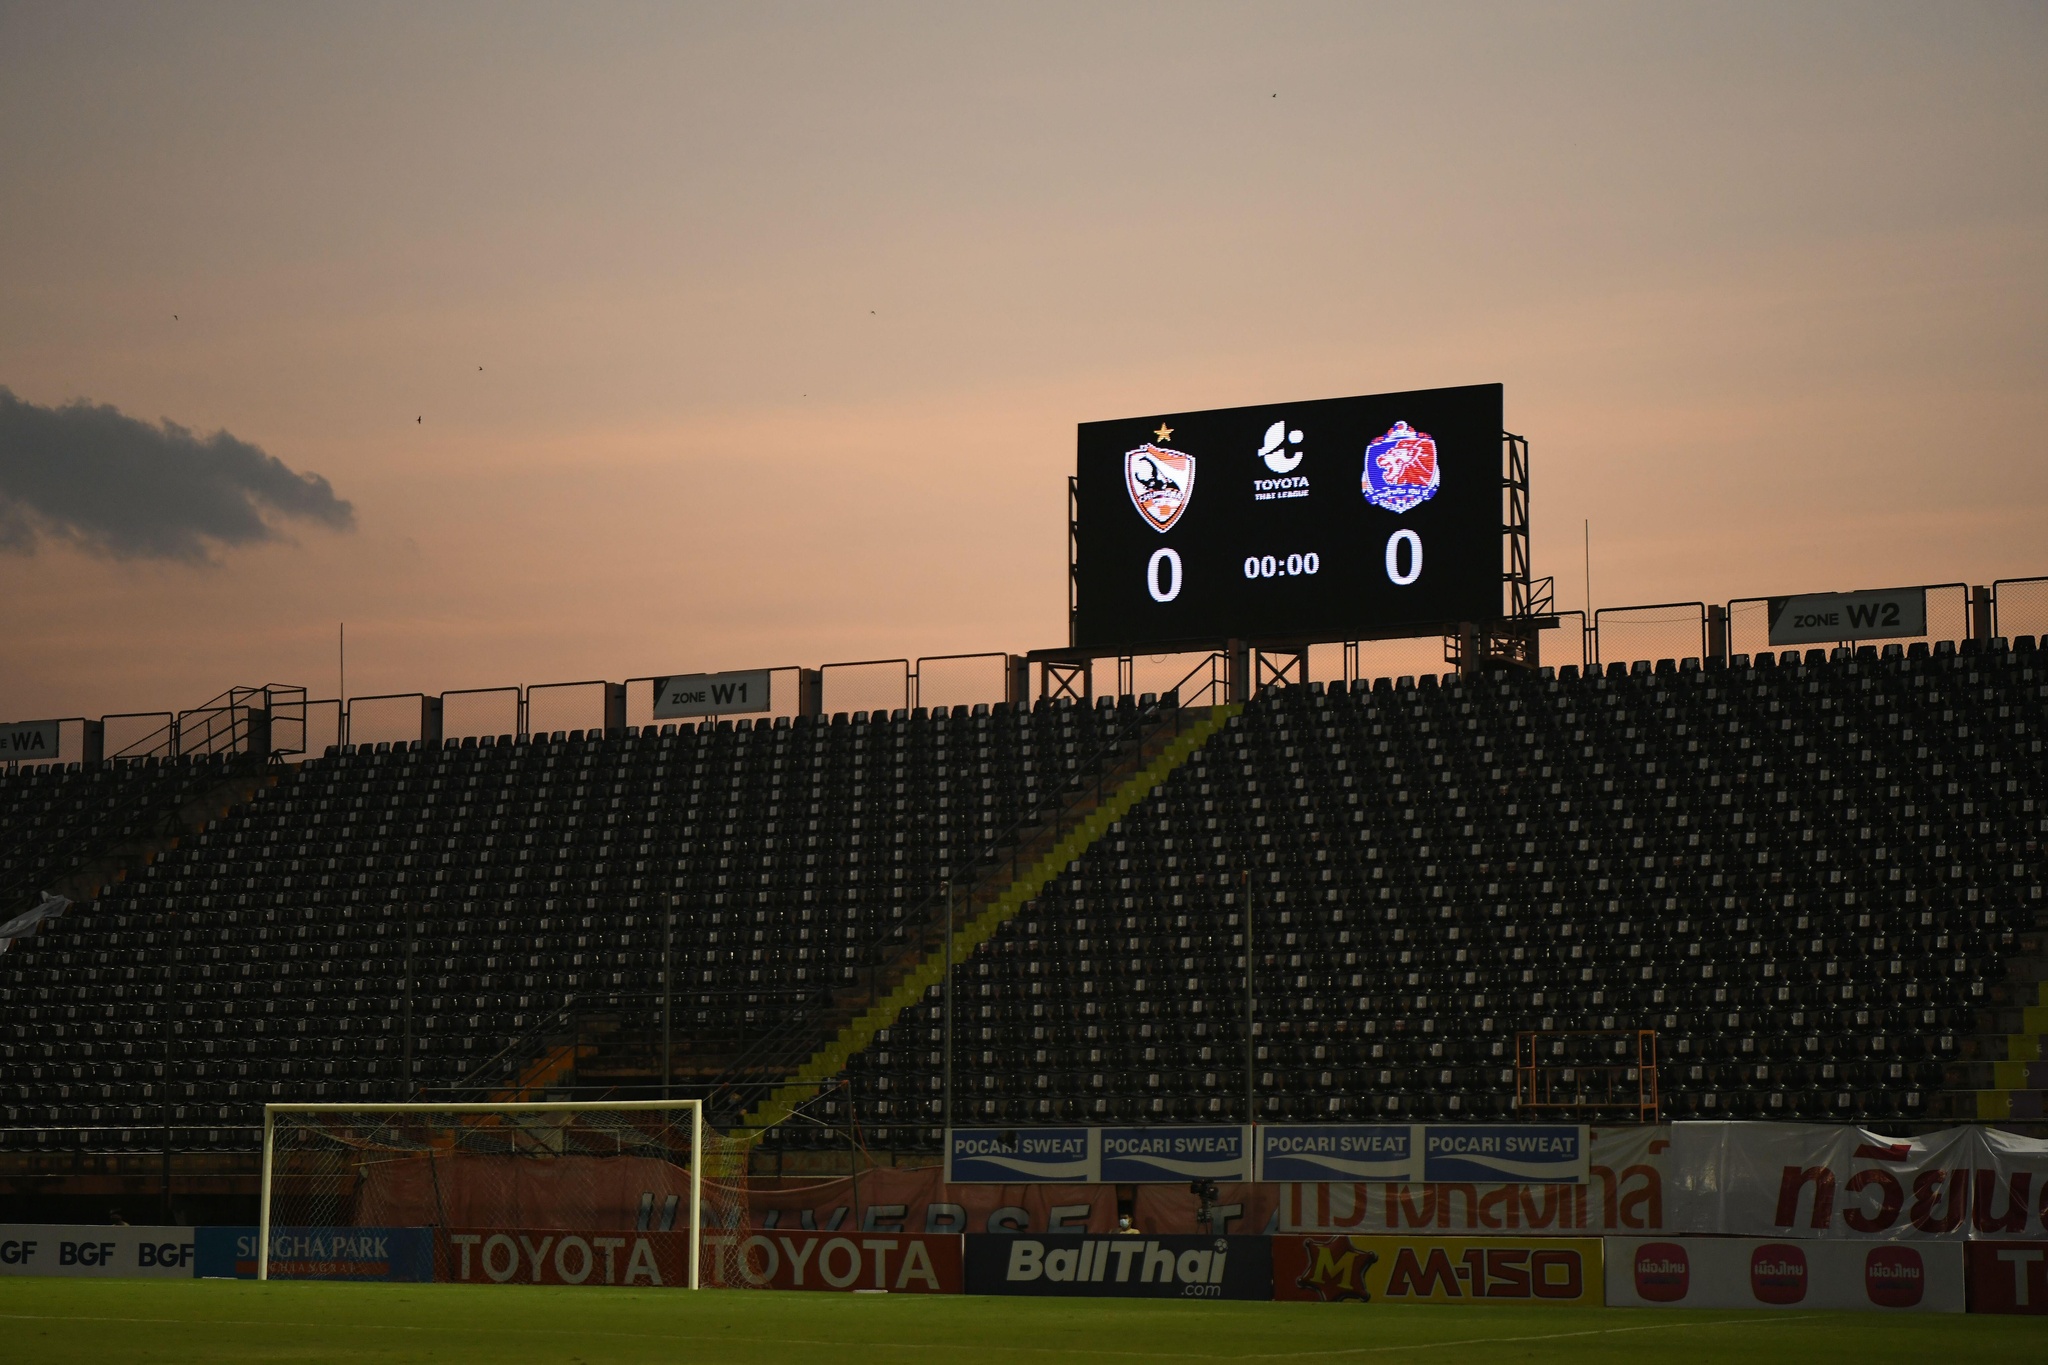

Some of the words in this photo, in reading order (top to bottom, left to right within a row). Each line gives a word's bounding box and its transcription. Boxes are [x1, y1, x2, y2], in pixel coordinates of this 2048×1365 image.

[1254, 476, 1309, 491] TOYOTA
[1277, 489, 1309, 499] LEAGUE
[1244, 552, 1320, 579] 00:00
[1385, 528, 1423, 585] 0
[1147, 547, 1182, 602] 0
[1794, 613, 1839, 628] ZONE
[1846, 602, 1900, 629] W2
[672, 691, 706, 705] ZONE
[711, 682, 747, 705] W1
[11, 731, 45, 751] WA
[1022, 1138, 1084, 1154] SWEAT
[1104, 1138, 1170, 1153] POCARI
[1174, 1137, 1239, 1153] SWEAT
[1267, 1137, 1336, 1152] POCARI
[1340, 1136, 1407, 1152] SWEAT
[1428, 1137, 1500, 1152] POCARI
[1505, 1136, 1575, 1152] SWEAT
[0, 1240, 37, 1264] GF
[60, 1241, 116, 1266] BGF
[139, 1243, 195, 1267] BGF
[332, 1236, 389, 1258] PARK
[450, 1232, 664, 1286] TOYOTA
[702, 1235, 941, 1289] TOYOTA
[1006, 1238, 1228, 1283] BallThai
[1312, 1246, 1356, 1289] M
[1385, 1247, 1582, 1299] M-150
[1180, 1283, 1222, 1297] .com
